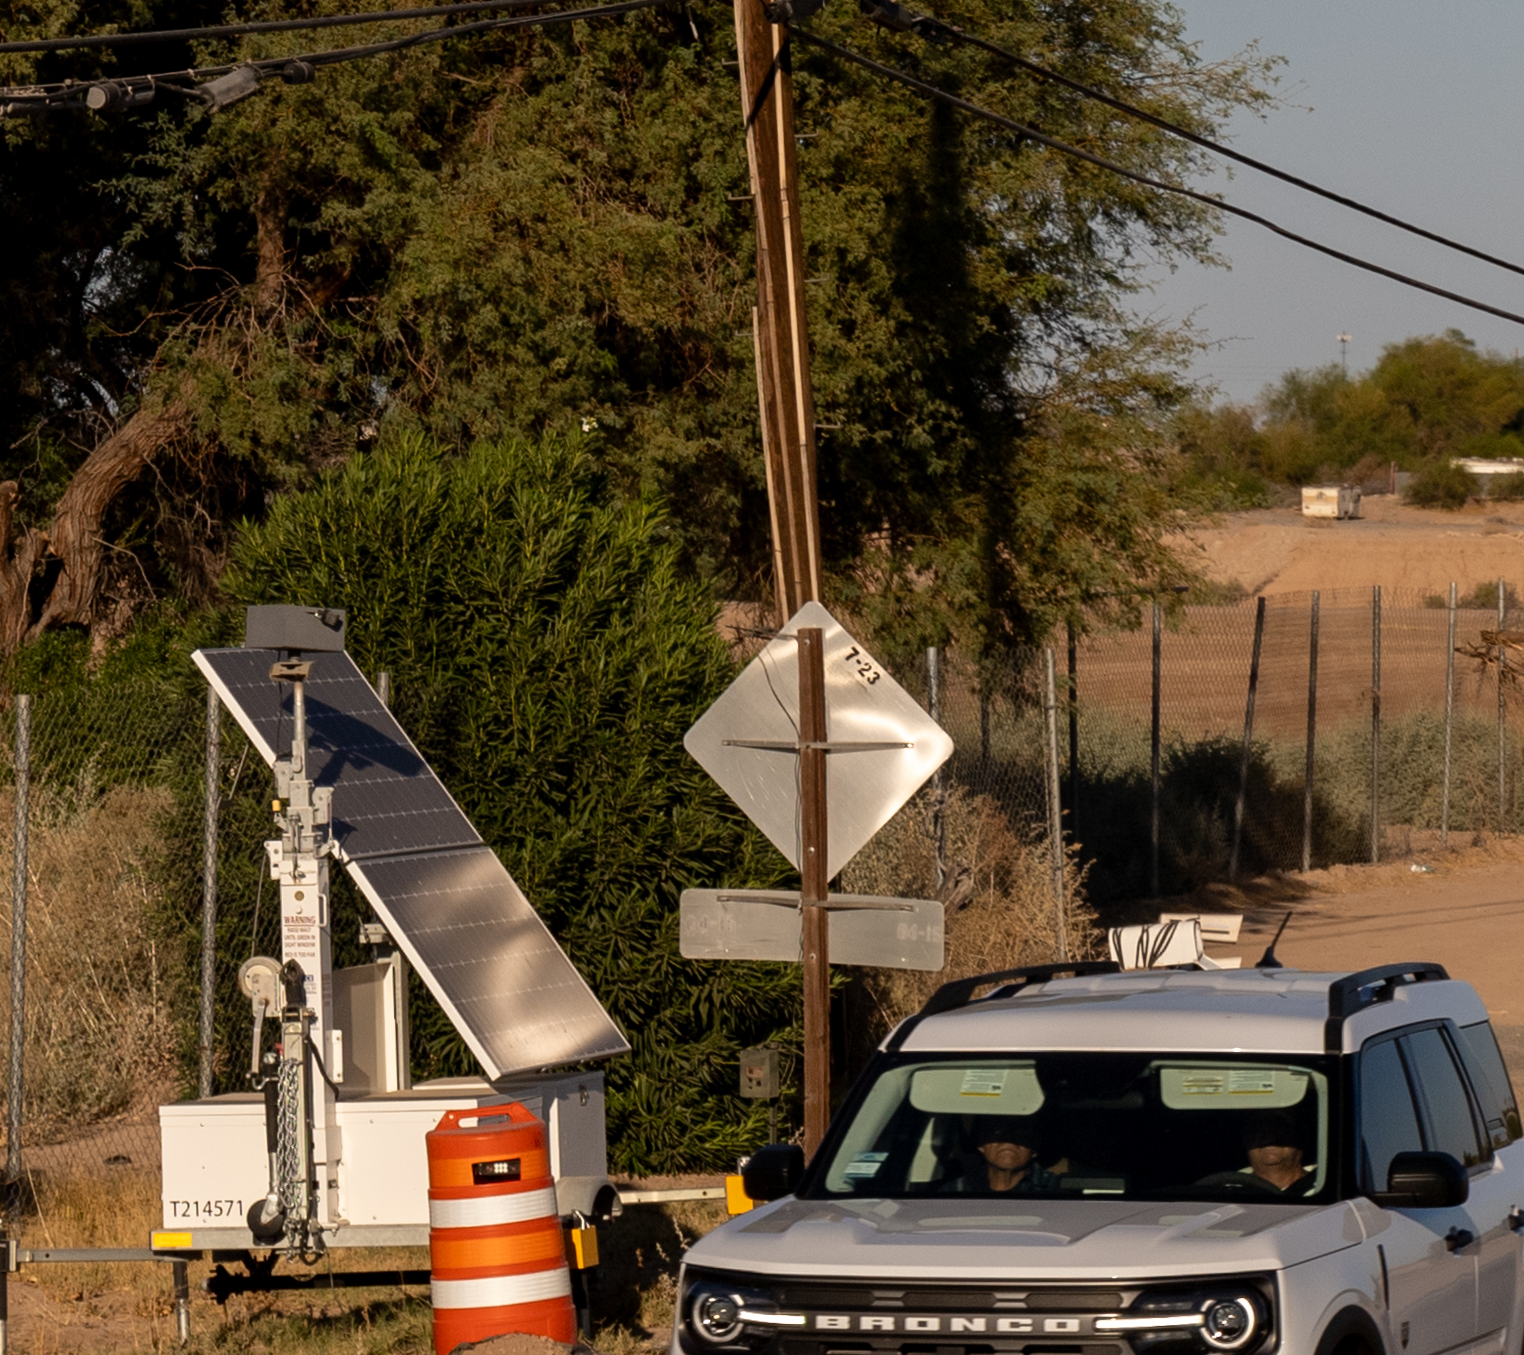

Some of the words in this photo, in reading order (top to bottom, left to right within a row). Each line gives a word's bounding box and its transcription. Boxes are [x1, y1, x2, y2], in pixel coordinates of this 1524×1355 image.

[845, 646, 881, 685] 7-23
[284, 915, 316, 924] WARNING
[169, 1199, 243, 1218] T214571
[815, 1315, 1080, 1333] BRONCO
